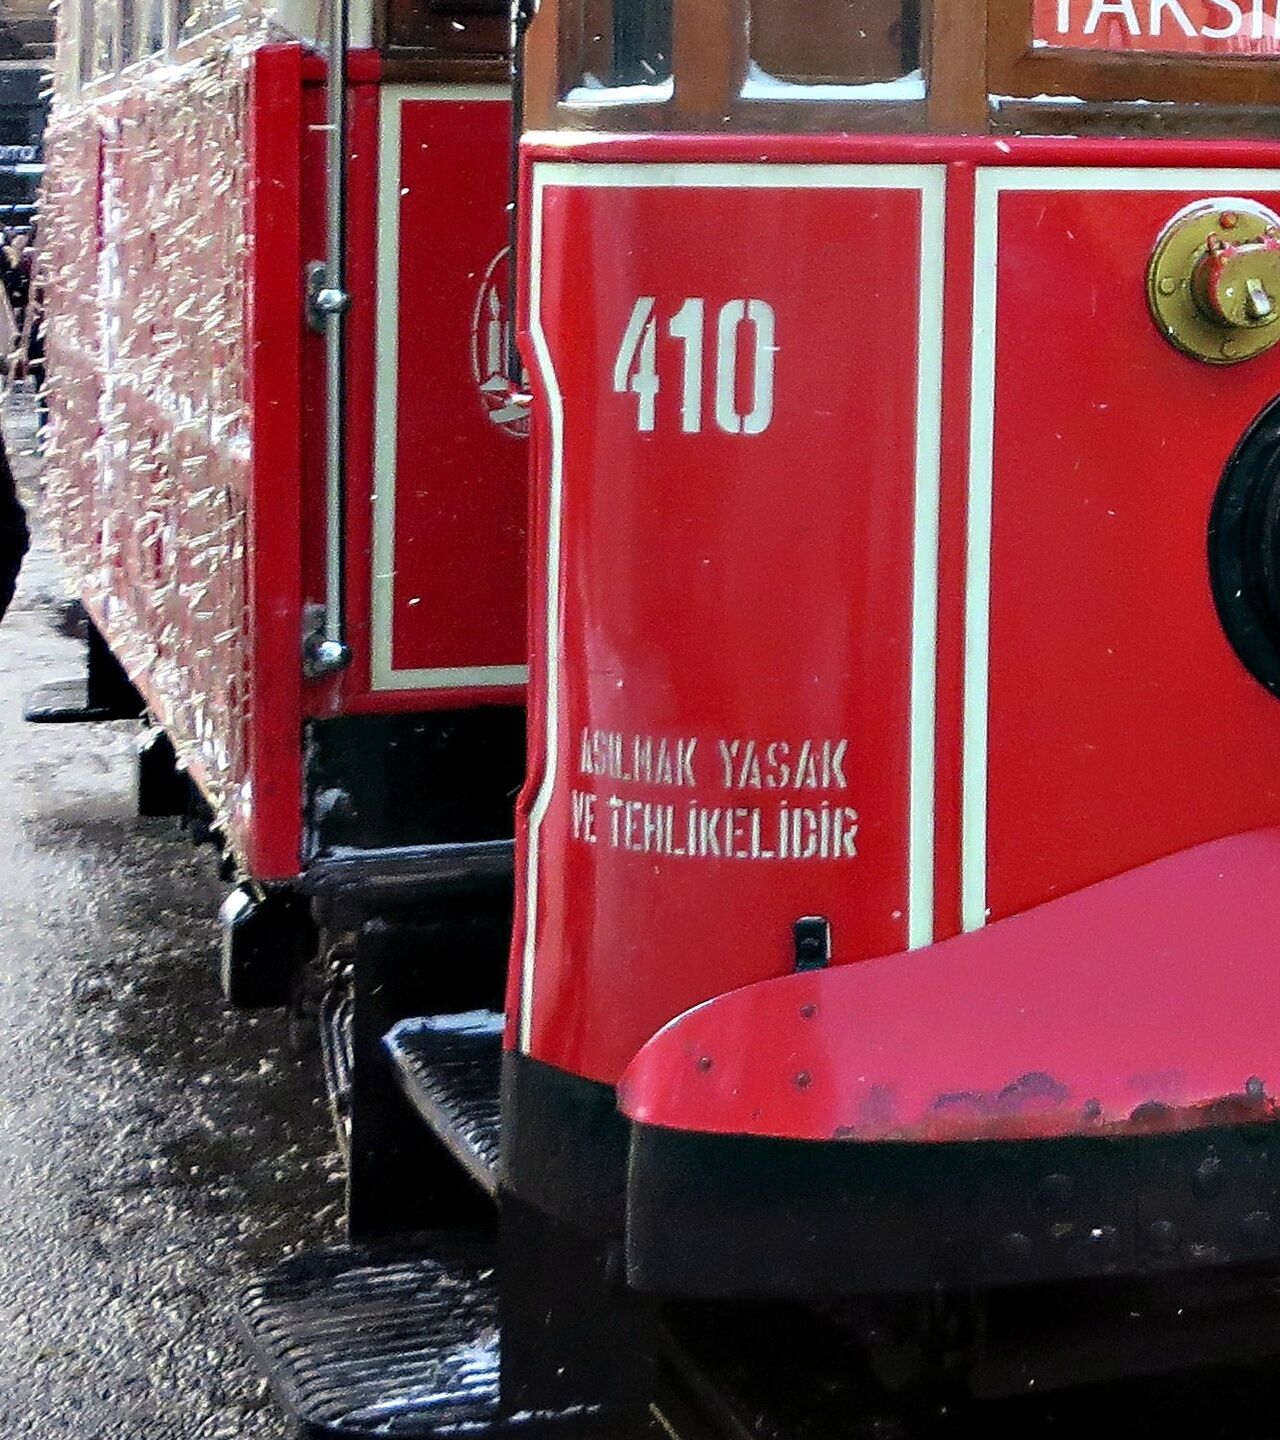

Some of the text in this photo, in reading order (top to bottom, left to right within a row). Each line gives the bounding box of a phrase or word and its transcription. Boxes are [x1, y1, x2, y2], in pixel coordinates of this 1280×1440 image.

[612, 296, 776, 435] 410
[581, 726, 848, 789] ASILMAK YASAK
[570, 789, 598, 844] VE
